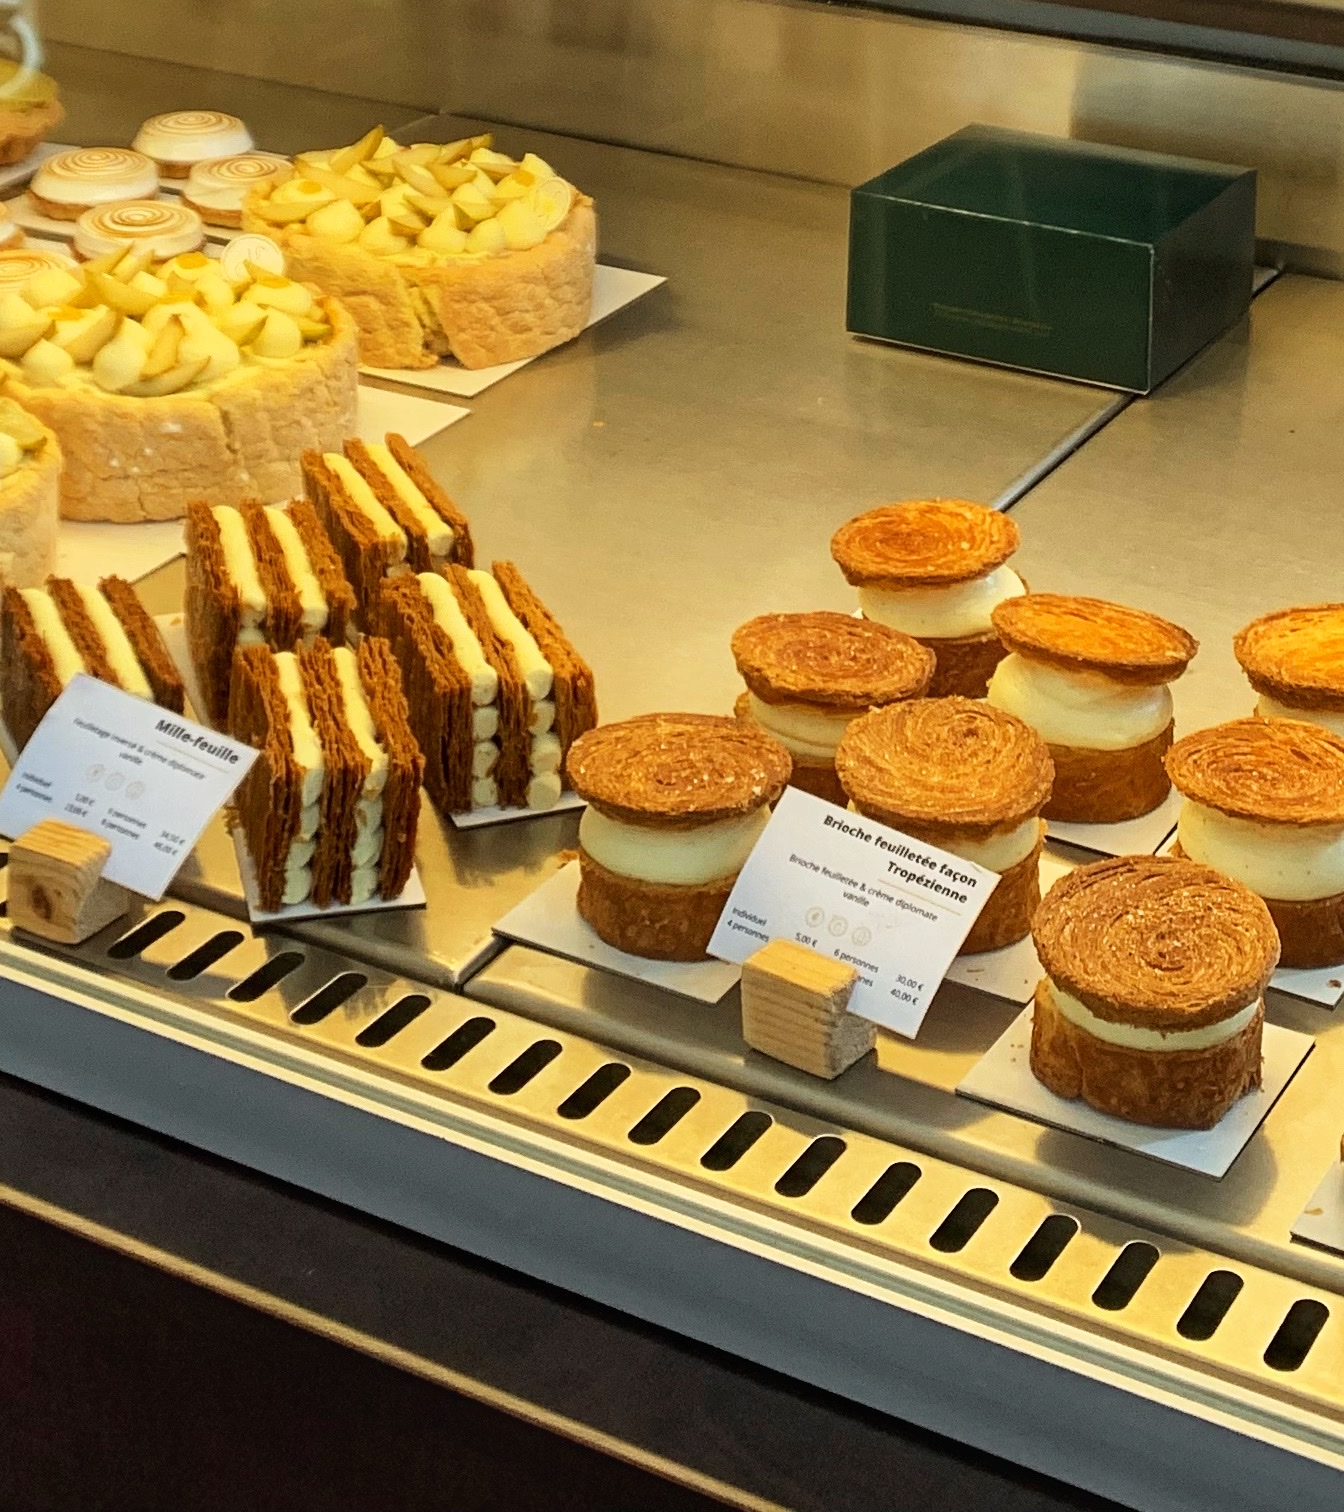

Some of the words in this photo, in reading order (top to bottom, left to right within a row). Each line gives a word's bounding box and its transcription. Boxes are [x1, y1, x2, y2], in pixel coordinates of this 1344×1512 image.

[155, 719, 239, 765] Mille-feuille
[823, 815, 872, 842] Brioche
[874, 836, 937, 871] feuilletée
[939, 863, 978, 888] façon
[887, 861, 968, 904] Tropézienne
[789, 853, 820, 873] Brioche
[821, 867, 858, 888] feuilletée
[859, 883, 866, 893] &
[867, 887, 894, 903] crème
[895, 899, 938, 921] diplomate
[843, 891, 870, 907] vanille
[727, 919, 733, 927] 4
[733, 923, 769, 942] personnes
[912, 997, 919, 1005] €
[732, 907, 767, 927] Individuel
[811, 939, 817, 948] €
[834, 949, 839, 957] 6
[840, 952, 879, 973] personnes
[917, 983, 924, 991] €
